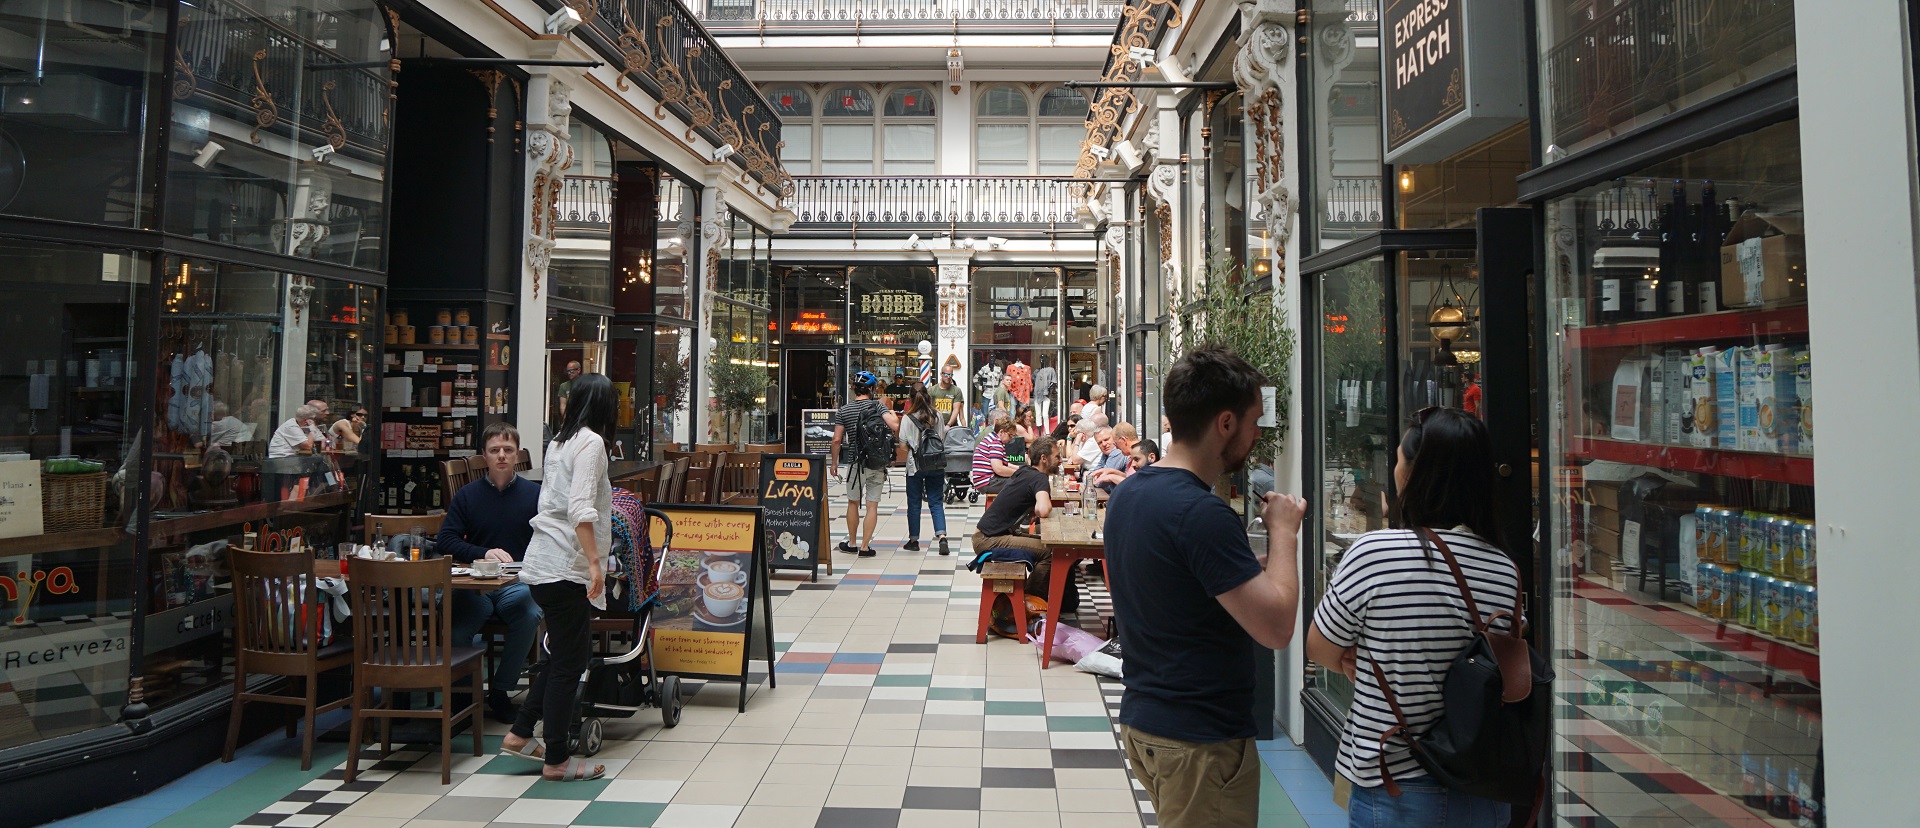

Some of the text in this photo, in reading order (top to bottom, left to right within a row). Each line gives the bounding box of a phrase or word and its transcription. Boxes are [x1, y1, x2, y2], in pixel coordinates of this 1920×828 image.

[1396, 18, 1450, 90] HATCH
[861, 294, 924, 305] BARBER
[935, 402, 952, 411] 2018
[2, 481, 24, 489] Plana
[765, 506, 814, 518] Breastfeeding
[675, 517, 702, 527] coffee
[704, 517, 724, 528] with
[726, 521, 751, 532] every
[766, 517, 811, 528] Mothers Welcome
[706, 531, 740, 541] sandwich
[703, 637, 725, 646] stunning
[28, 637, 126, 665] cerveza
